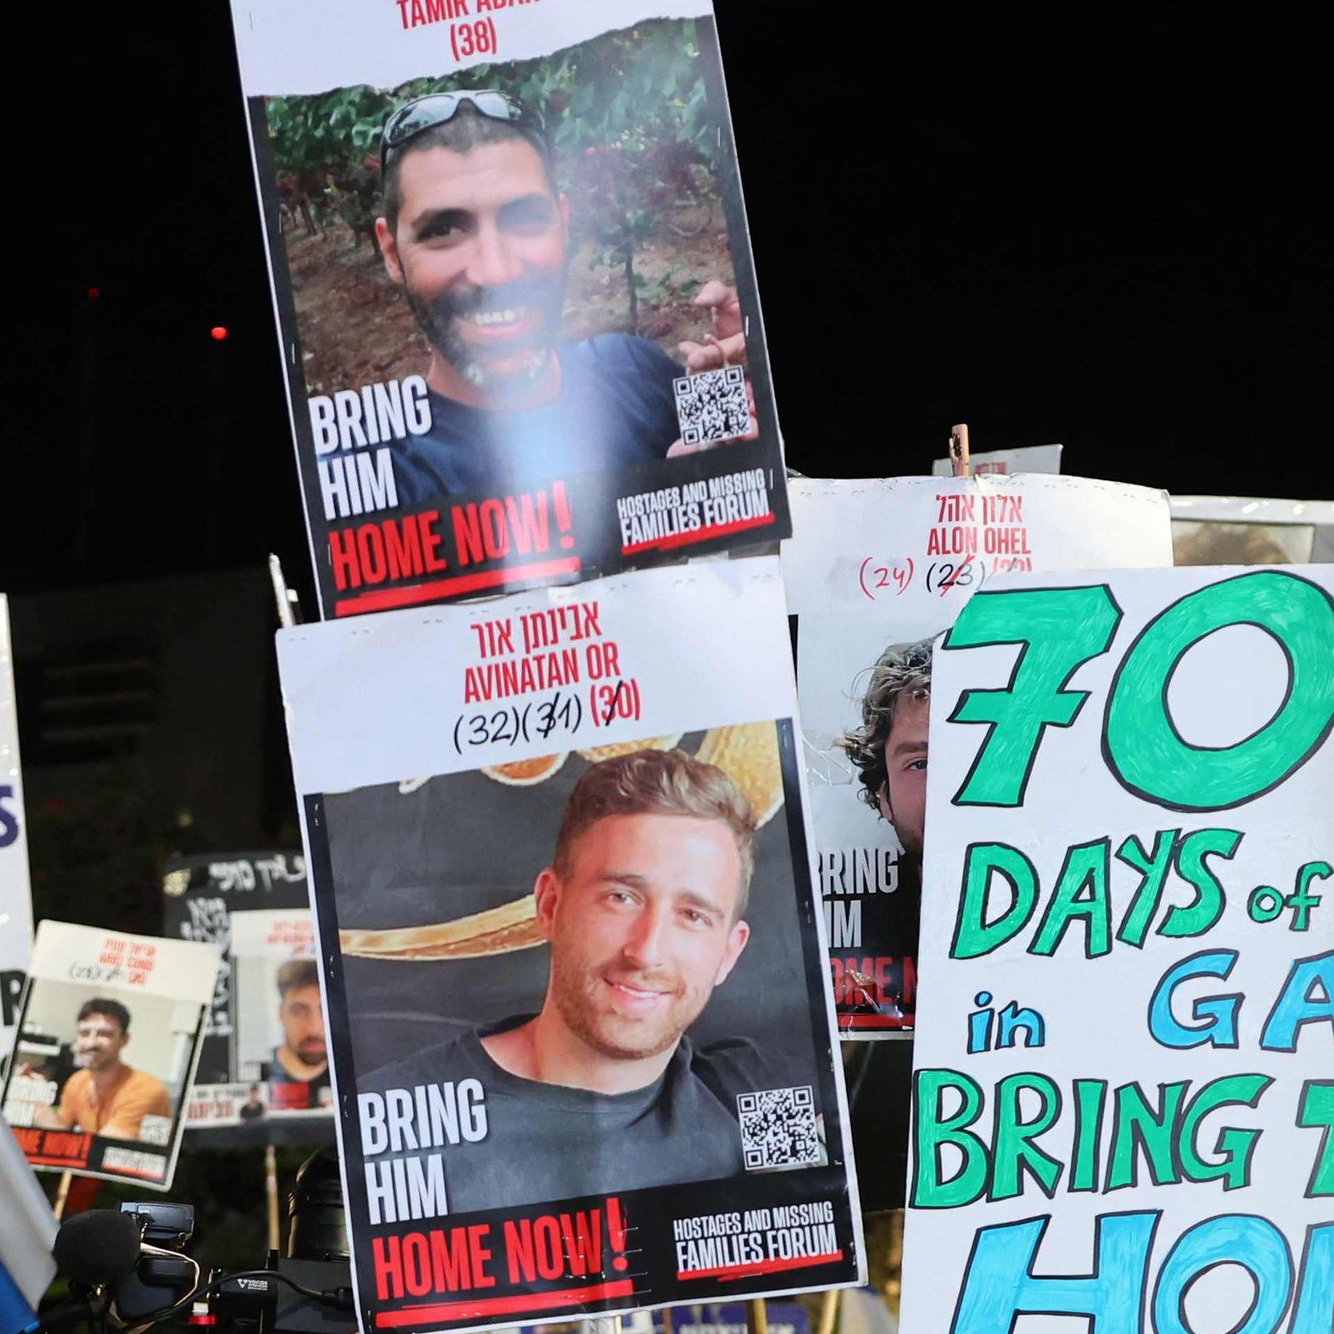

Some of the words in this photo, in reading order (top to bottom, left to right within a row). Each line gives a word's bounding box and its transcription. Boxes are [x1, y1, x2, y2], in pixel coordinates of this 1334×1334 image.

[450, 16, 497, 62] (38)
[308, 374, 432, 453] BRING
[316, 447, 399, 519] HIM
[617, 487, 680, 519] HOSTAGES
[681, 482, 706, 505] AND
[707, 468, 766, 501] MISSING
[935, 494, 974, 523] אהל
[328, 508, 447, 592] HOME
[451, 480, 574, 566] NOW!
[620, 504, 700, 547] FAMILIES
[703, 489, 770, 533] FORUM
[981, 495, 1022, 526] אלון
[927, 527, 978, 555] ALON
[984, 528, 1031, 554] OHEL
[860, 556, 913, 600] (24)
[470, 619, 515, 658] אור
[520, 602, 602, 654] אבינתן
[464, 648, 579, 704] AVINATAN
[586, 641, 621, 680] OR
[818, 848, 899, 895] RING
[949, 827, 1245, 960] DAYS
[1247, 861, 1334, 931] of
[829, 957, 892, 1005] OME
[967, 990, 1046, 1056] in
[357, 1077, 488, 1158] BRING
[909, 1068, 1275, 1210] BRING
[365, 1154, 448, 1226] HIM
[673, 1211, 741, 1240] HOSTAGES
[743, 1208, 769, 1231] AND
[771, 1202, 833, 1227] MISSING
[371, 1219, 501, 1302] HOME
[504, 1197, 629, 1287] NOW!
[675, 1235, 764, 1272] FAMILIES
[766, 1223, 837, 1261] FORUM
